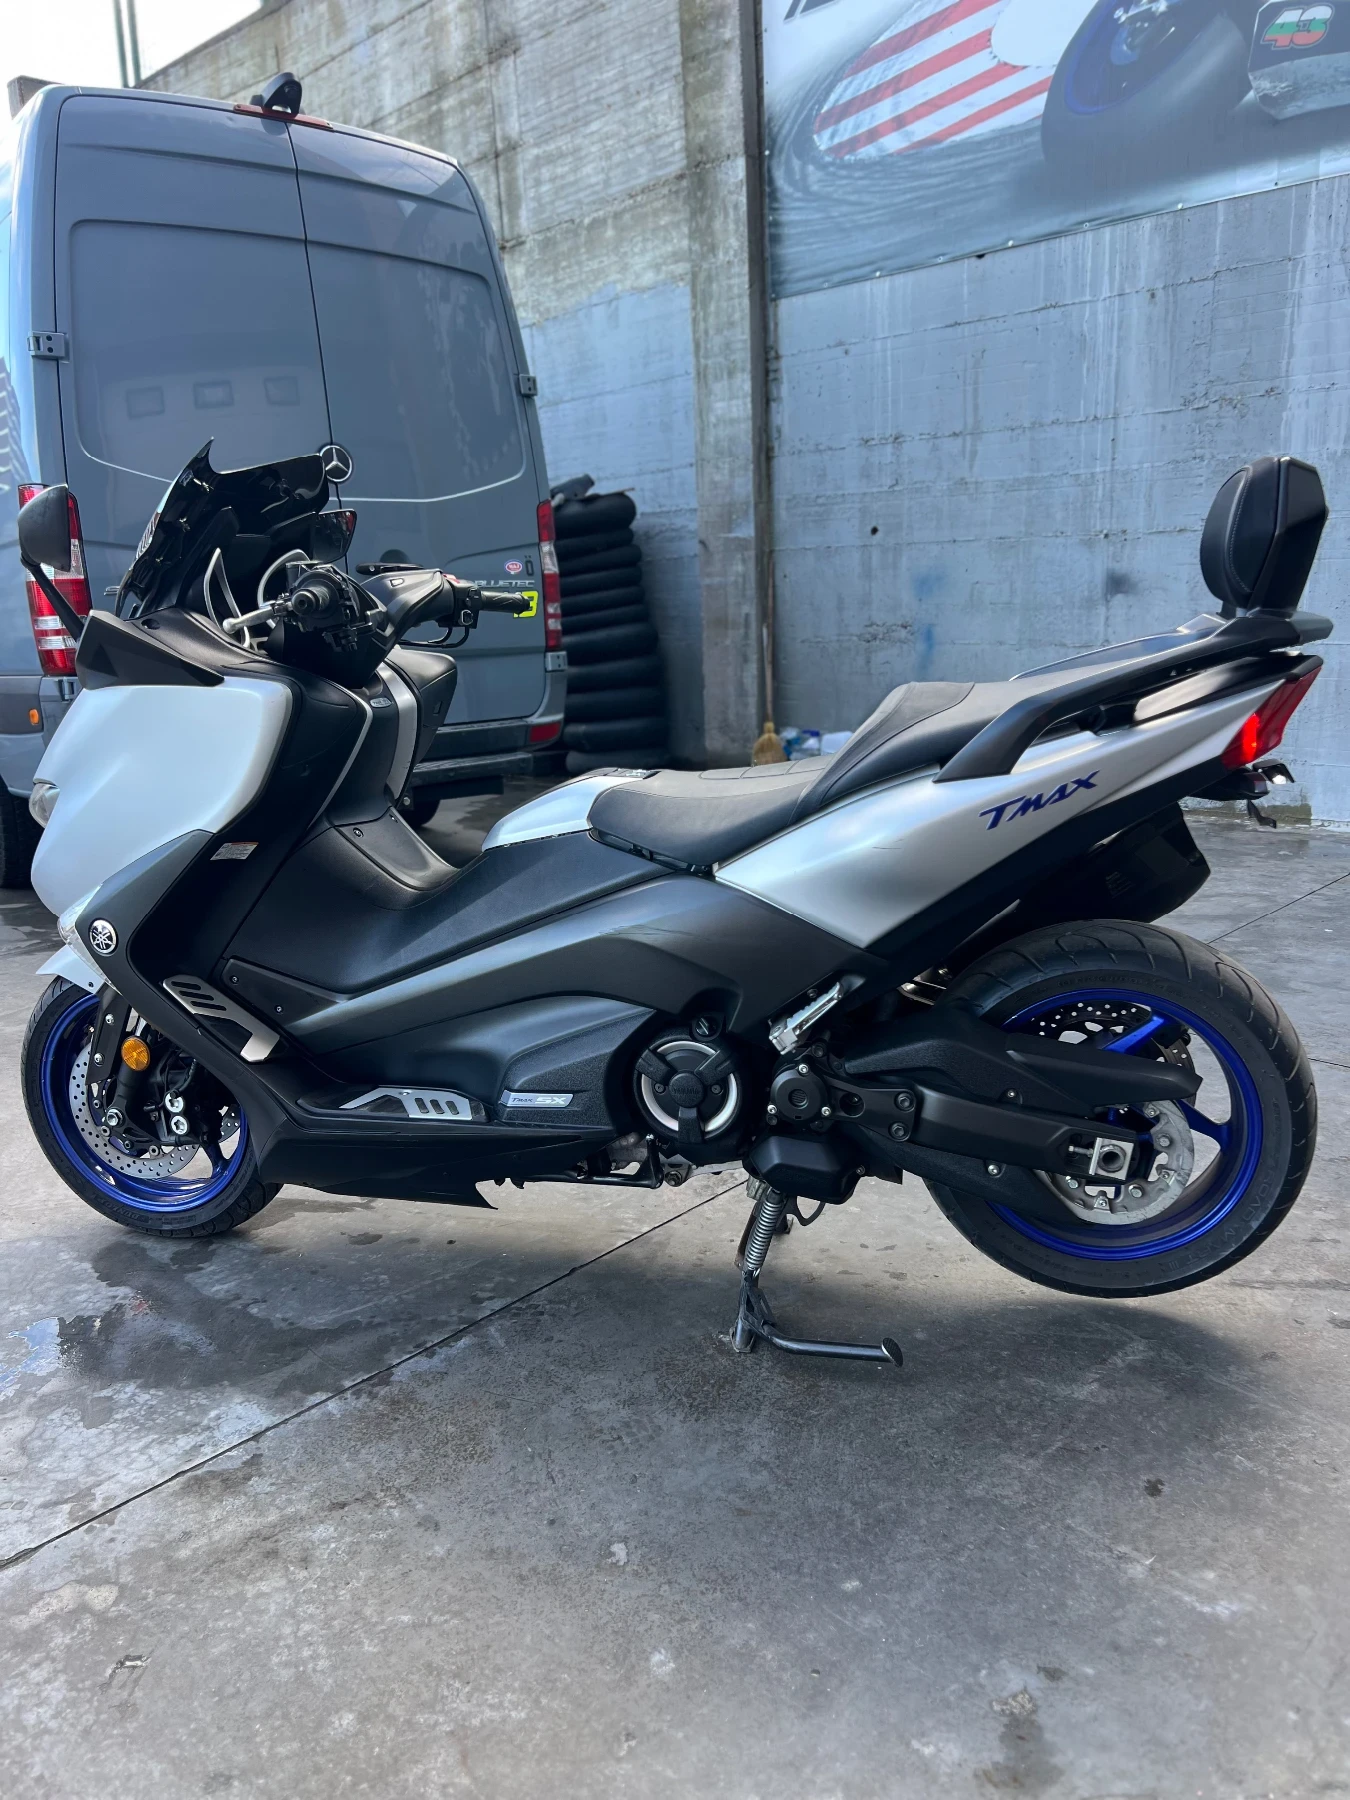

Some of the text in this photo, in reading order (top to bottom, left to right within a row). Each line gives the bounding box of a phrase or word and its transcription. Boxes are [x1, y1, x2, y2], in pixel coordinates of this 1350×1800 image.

[1263, 5, 1333, 47] 43
[513, 590, 539, 618] 3
[978, 769, 1100, 831] TMAX
[534, 1096, 567, 1105] SX
